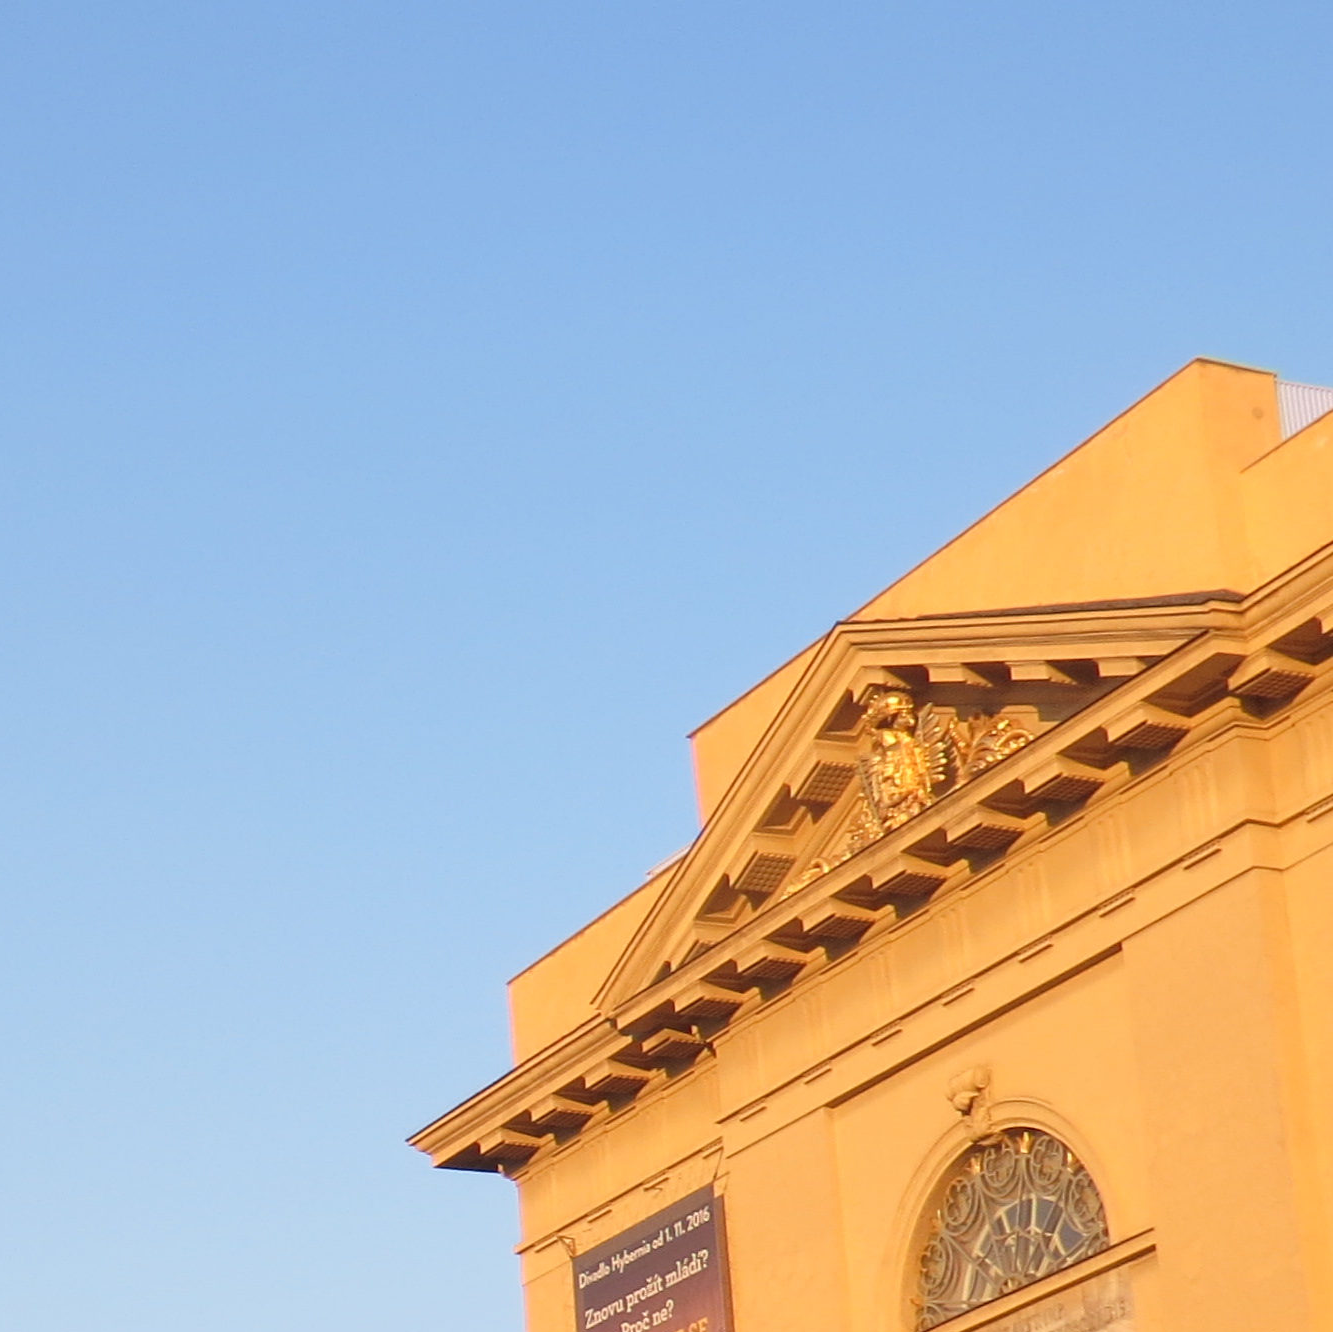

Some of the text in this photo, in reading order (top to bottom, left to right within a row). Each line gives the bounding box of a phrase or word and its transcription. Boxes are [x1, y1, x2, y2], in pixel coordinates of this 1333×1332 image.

[578, 1262, 611, 1290] Divadlo
[611, 1240, 652, 1274] Hybernia
[652, 1230, 664, 1250] od
[686, 1205, 711, 1232] 2016
[584, 1249, 709, 1330] Znovu prožít mládí?
[652, 1299, 675, 1327] ne?
